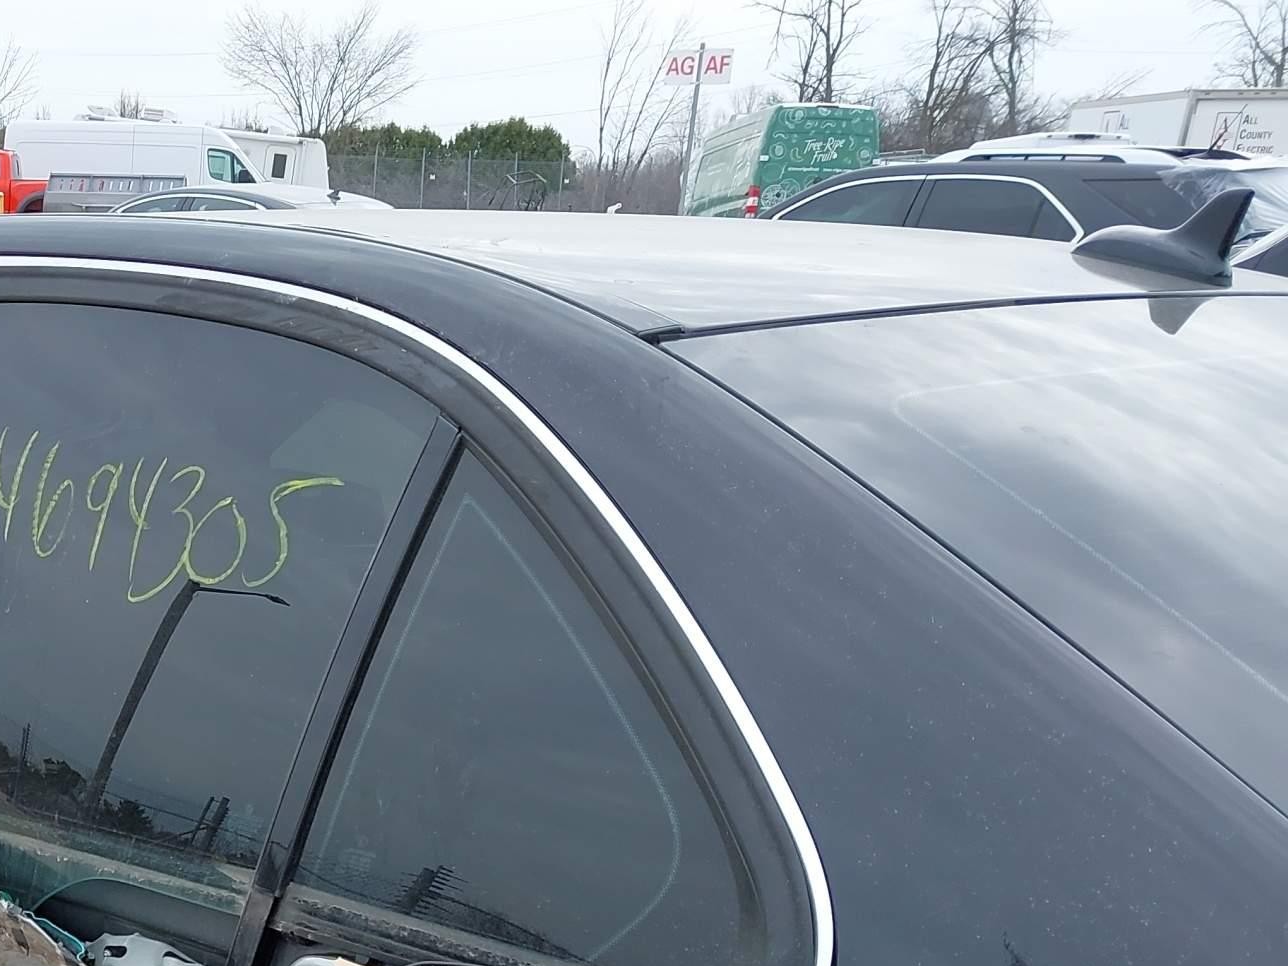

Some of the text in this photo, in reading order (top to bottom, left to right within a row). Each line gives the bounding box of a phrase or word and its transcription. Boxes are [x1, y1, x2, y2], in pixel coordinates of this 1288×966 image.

[665, 56, 695, 76] AG
[704, 55, 731, 75] AF
[1239, 128, 1274, 140] COUNTY
[803, 137, 846, 154] Tree-Ripe
[811, 150, 835, 165] Fruit
